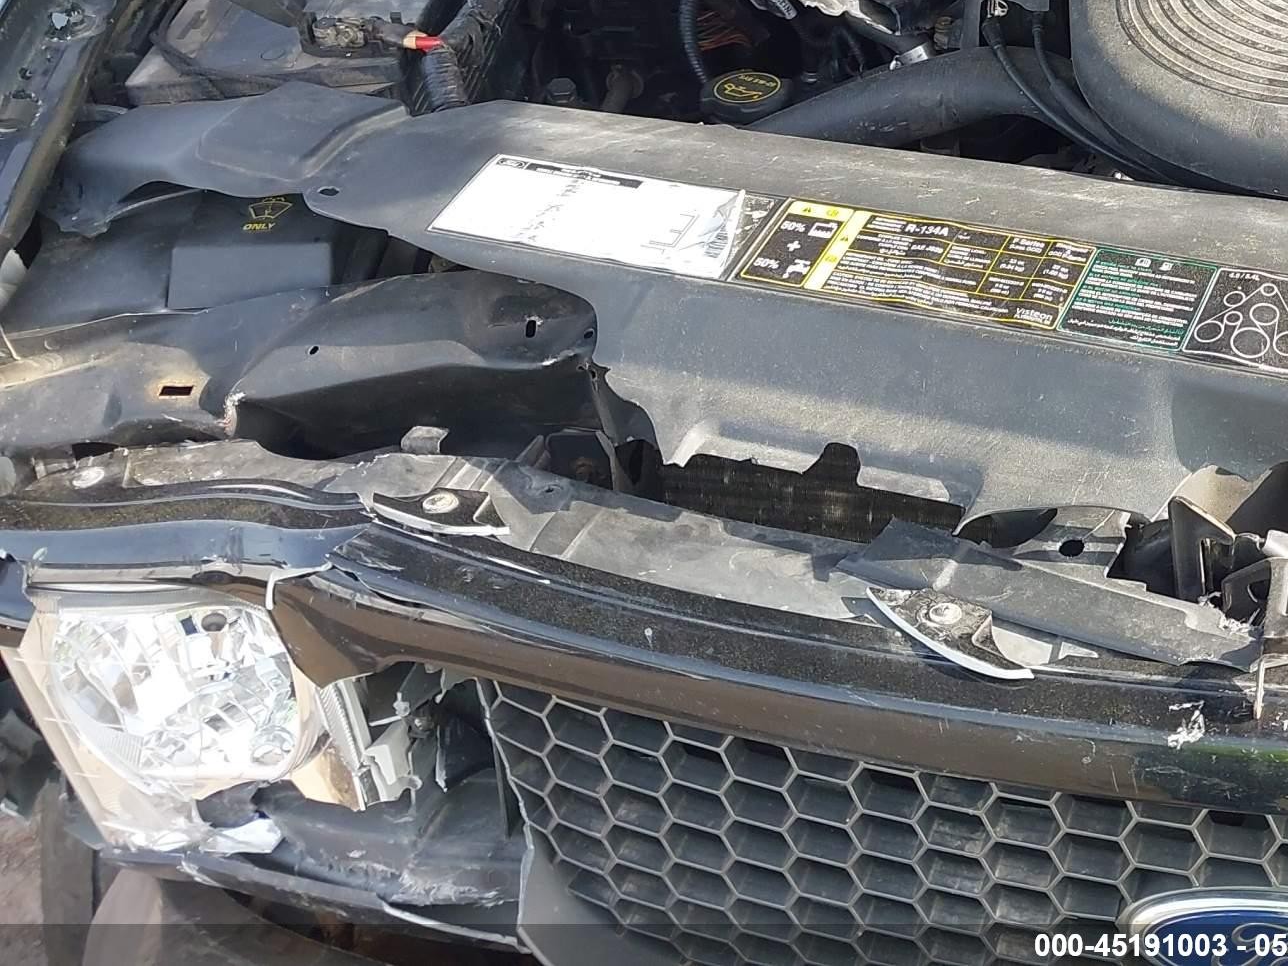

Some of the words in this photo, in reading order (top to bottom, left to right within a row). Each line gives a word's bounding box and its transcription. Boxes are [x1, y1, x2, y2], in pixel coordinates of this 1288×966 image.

[242, 222, 276, 231] ONLY
[781, 220, 806, 233] 50%
[905, 223, 949, 237] R-134A
[752, 257, 780, 270] 50%
[1016, 307, 1053, 322] Visteon
